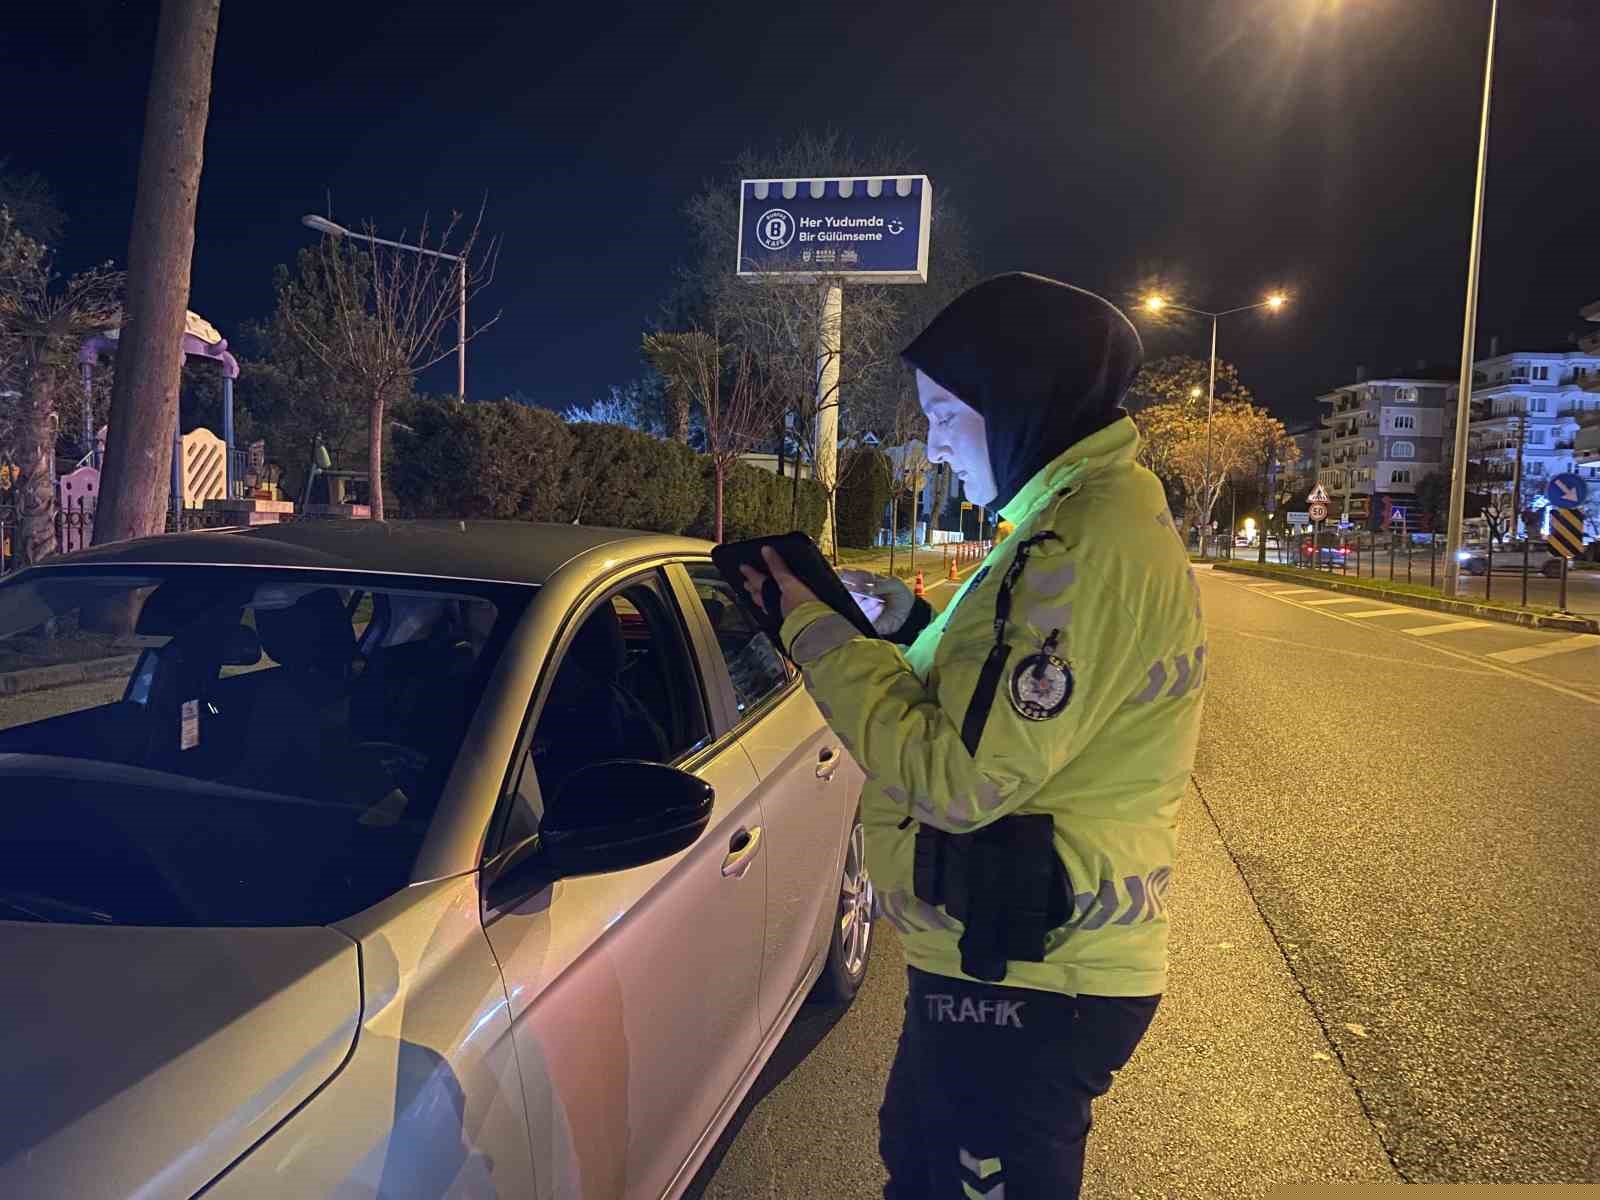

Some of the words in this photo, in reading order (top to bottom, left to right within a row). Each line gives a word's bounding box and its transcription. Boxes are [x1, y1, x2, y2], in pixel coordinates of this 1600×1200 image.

[800, 217, 822, 227] Her
[825, 216, 883, 228] Yudumda
[799, 232, 816, 241] Bir
[817, 232, 882, 241] Gülümseme
[1313, 507, 1323, 515] 50
